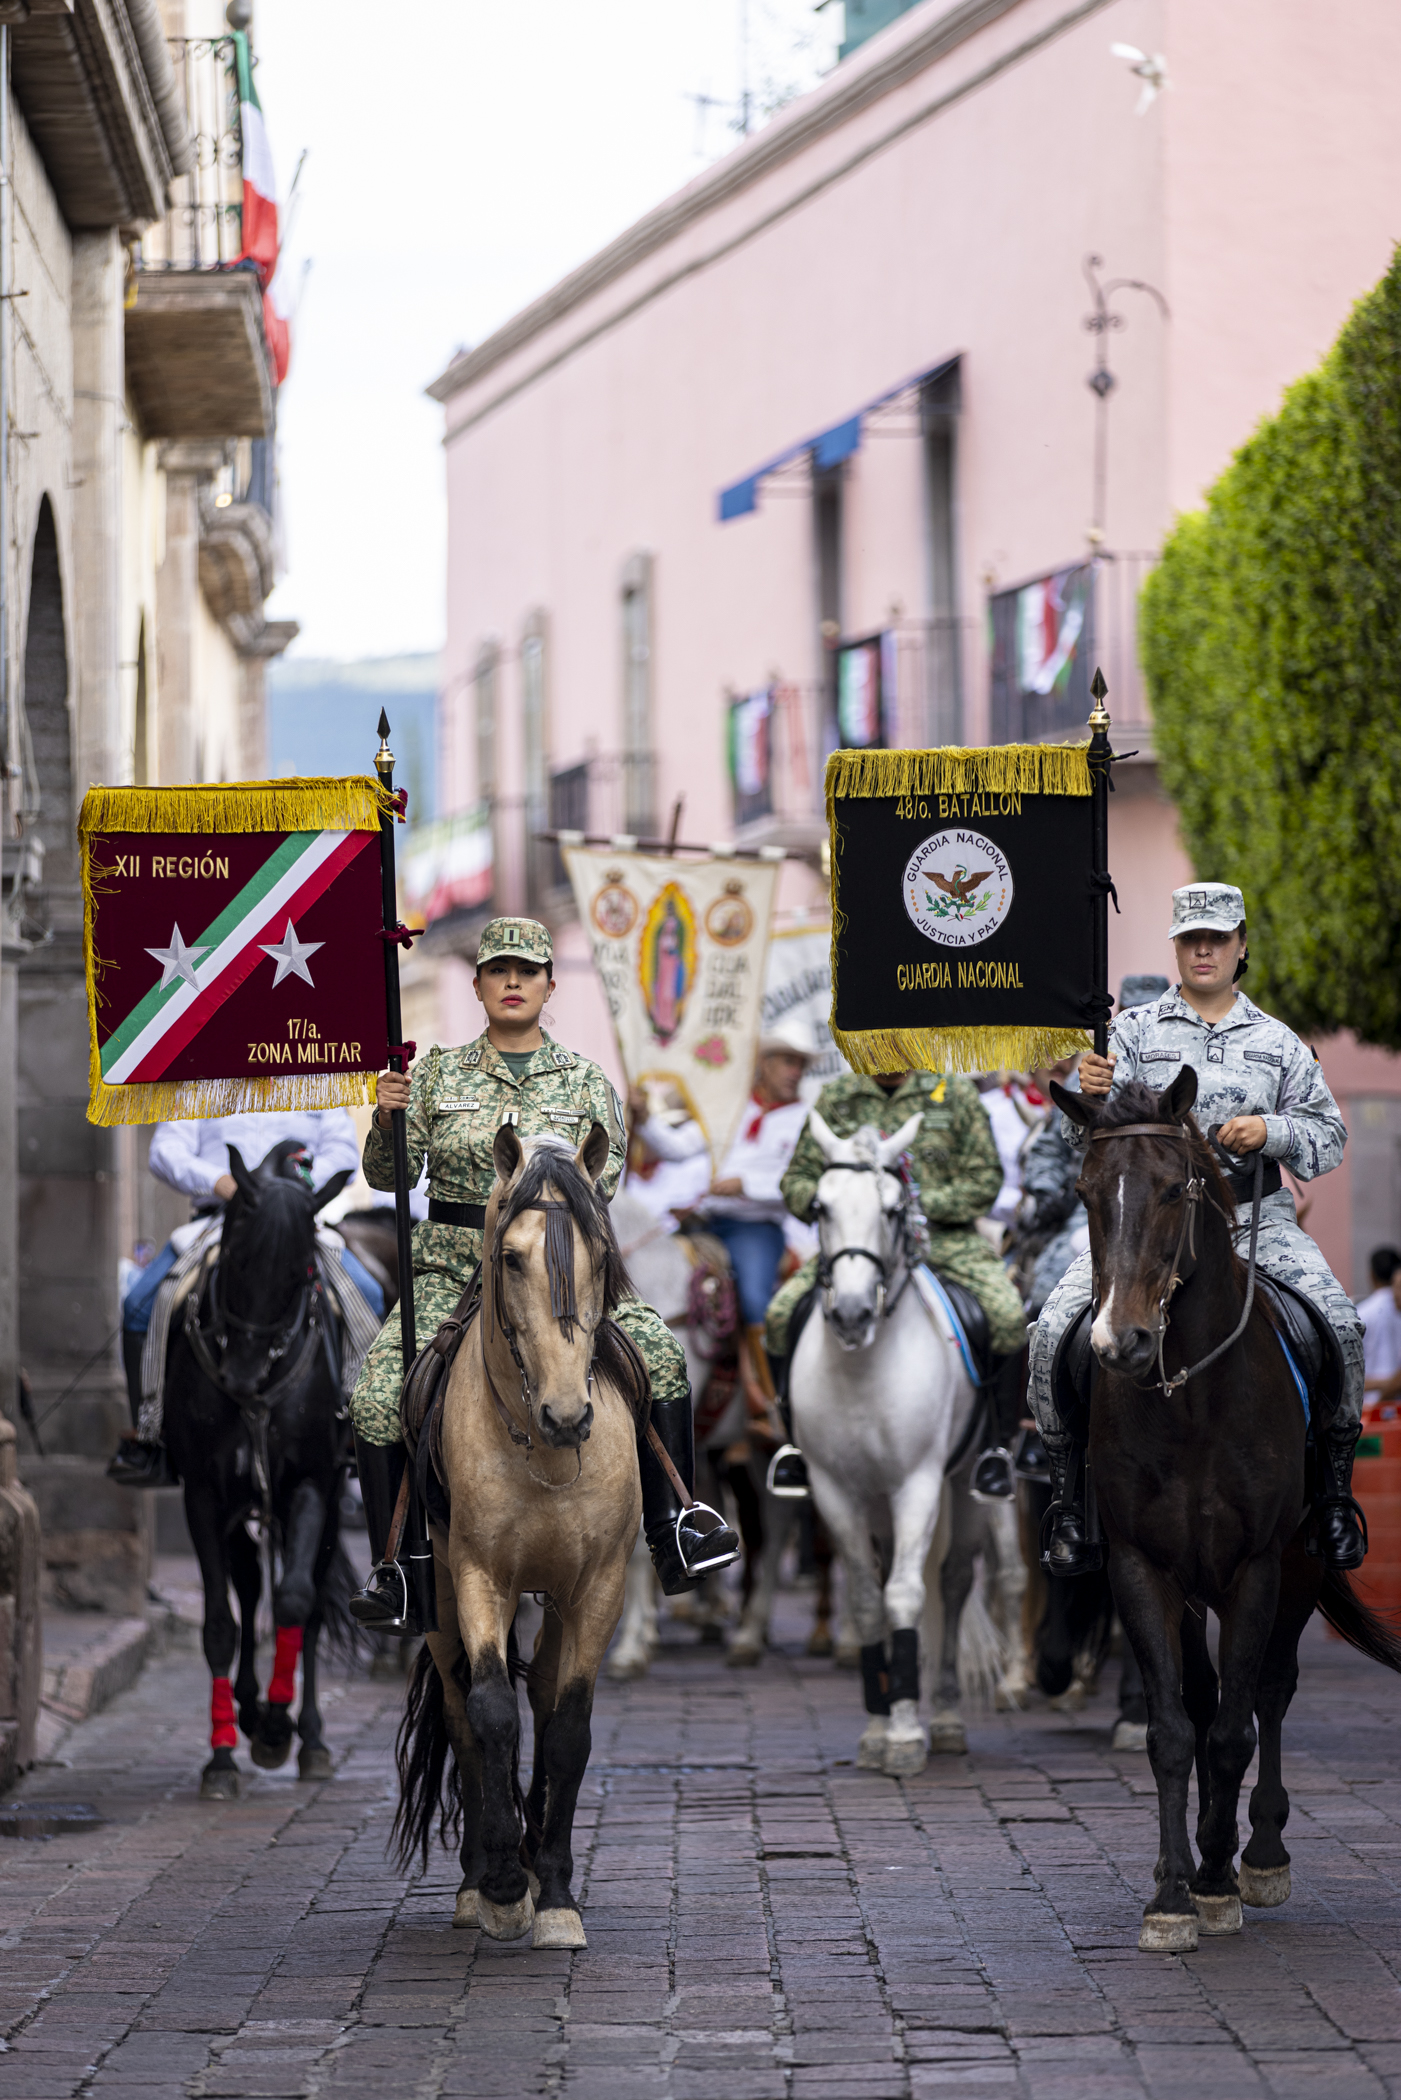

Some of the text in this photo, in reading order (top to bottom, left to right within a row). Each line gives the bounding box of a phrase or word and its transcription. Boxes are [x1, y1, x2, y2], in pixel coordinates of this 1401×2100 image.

[938, 791, 1022, 818] BATALLON
[114, 849, 229, 879] XII REGIÓN
[907, 832, 1009, 882] GUARDIA NACIONAL
[916, 916, 999, 945] JUSTICIA Y PAZ
[897, 960, 1024, 991] GUARDIA NACIONAL
[286, 1018, 321, 1040] 17/a.
[247, 1042, 362, 1064] ZONA MILITAR
[1145, 1052, 1177, 1060] MORALES
